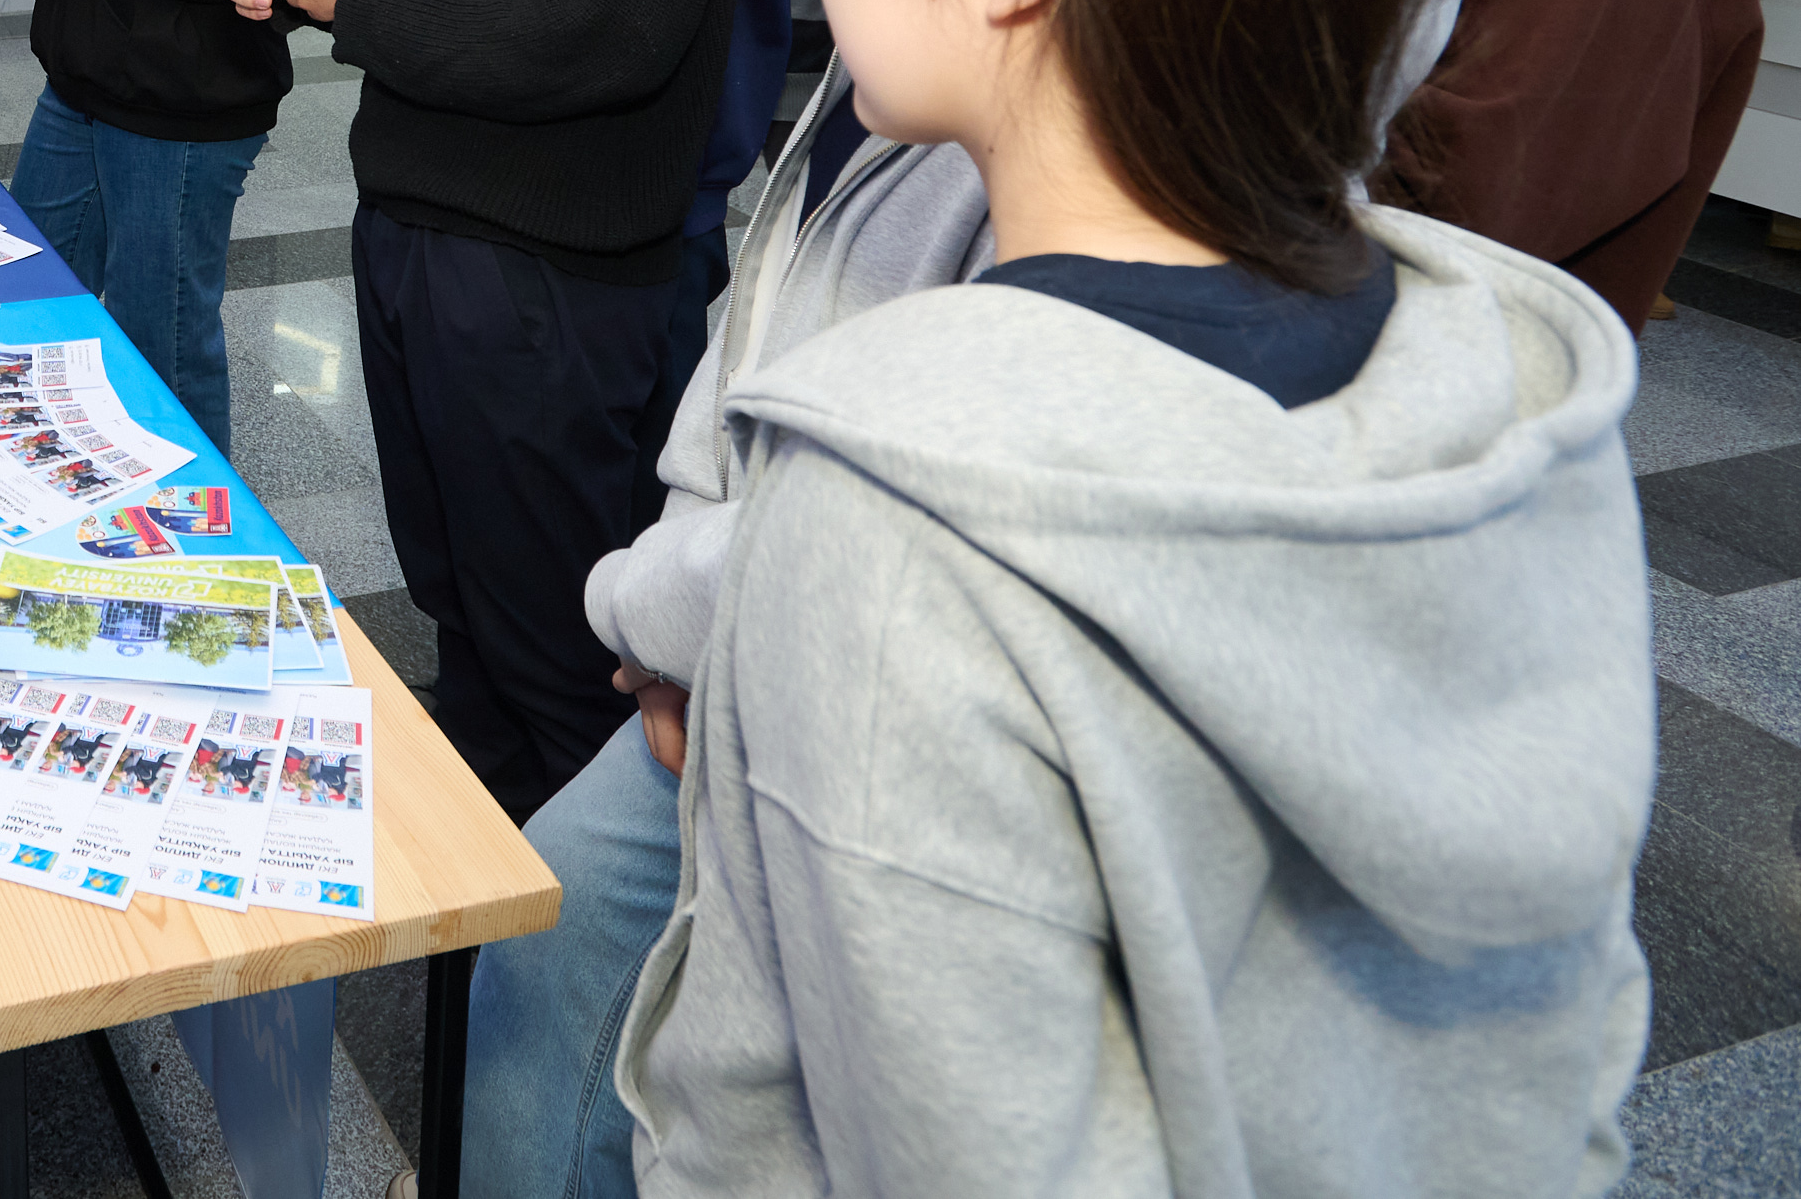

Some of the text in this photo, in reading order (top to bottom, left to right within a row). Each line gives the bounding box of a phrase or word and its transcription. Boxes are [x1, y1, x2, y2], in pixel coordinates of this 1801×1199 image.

[54, 566, 173, 587] UNIVERSITY
[51, 577, 169, 598] KOZYBAYEV
[43, 824, 63, 834] БІР
[110, 848, 131, 858] БІР
[158, 835, 242, 859] БІР УАҚЫТТА
[202, 855, 224, 865] ЕКІ
[269, 846, 355, 867] БІР УАҚЫТТА
[316, 865, 339, 875] ЕКІ
